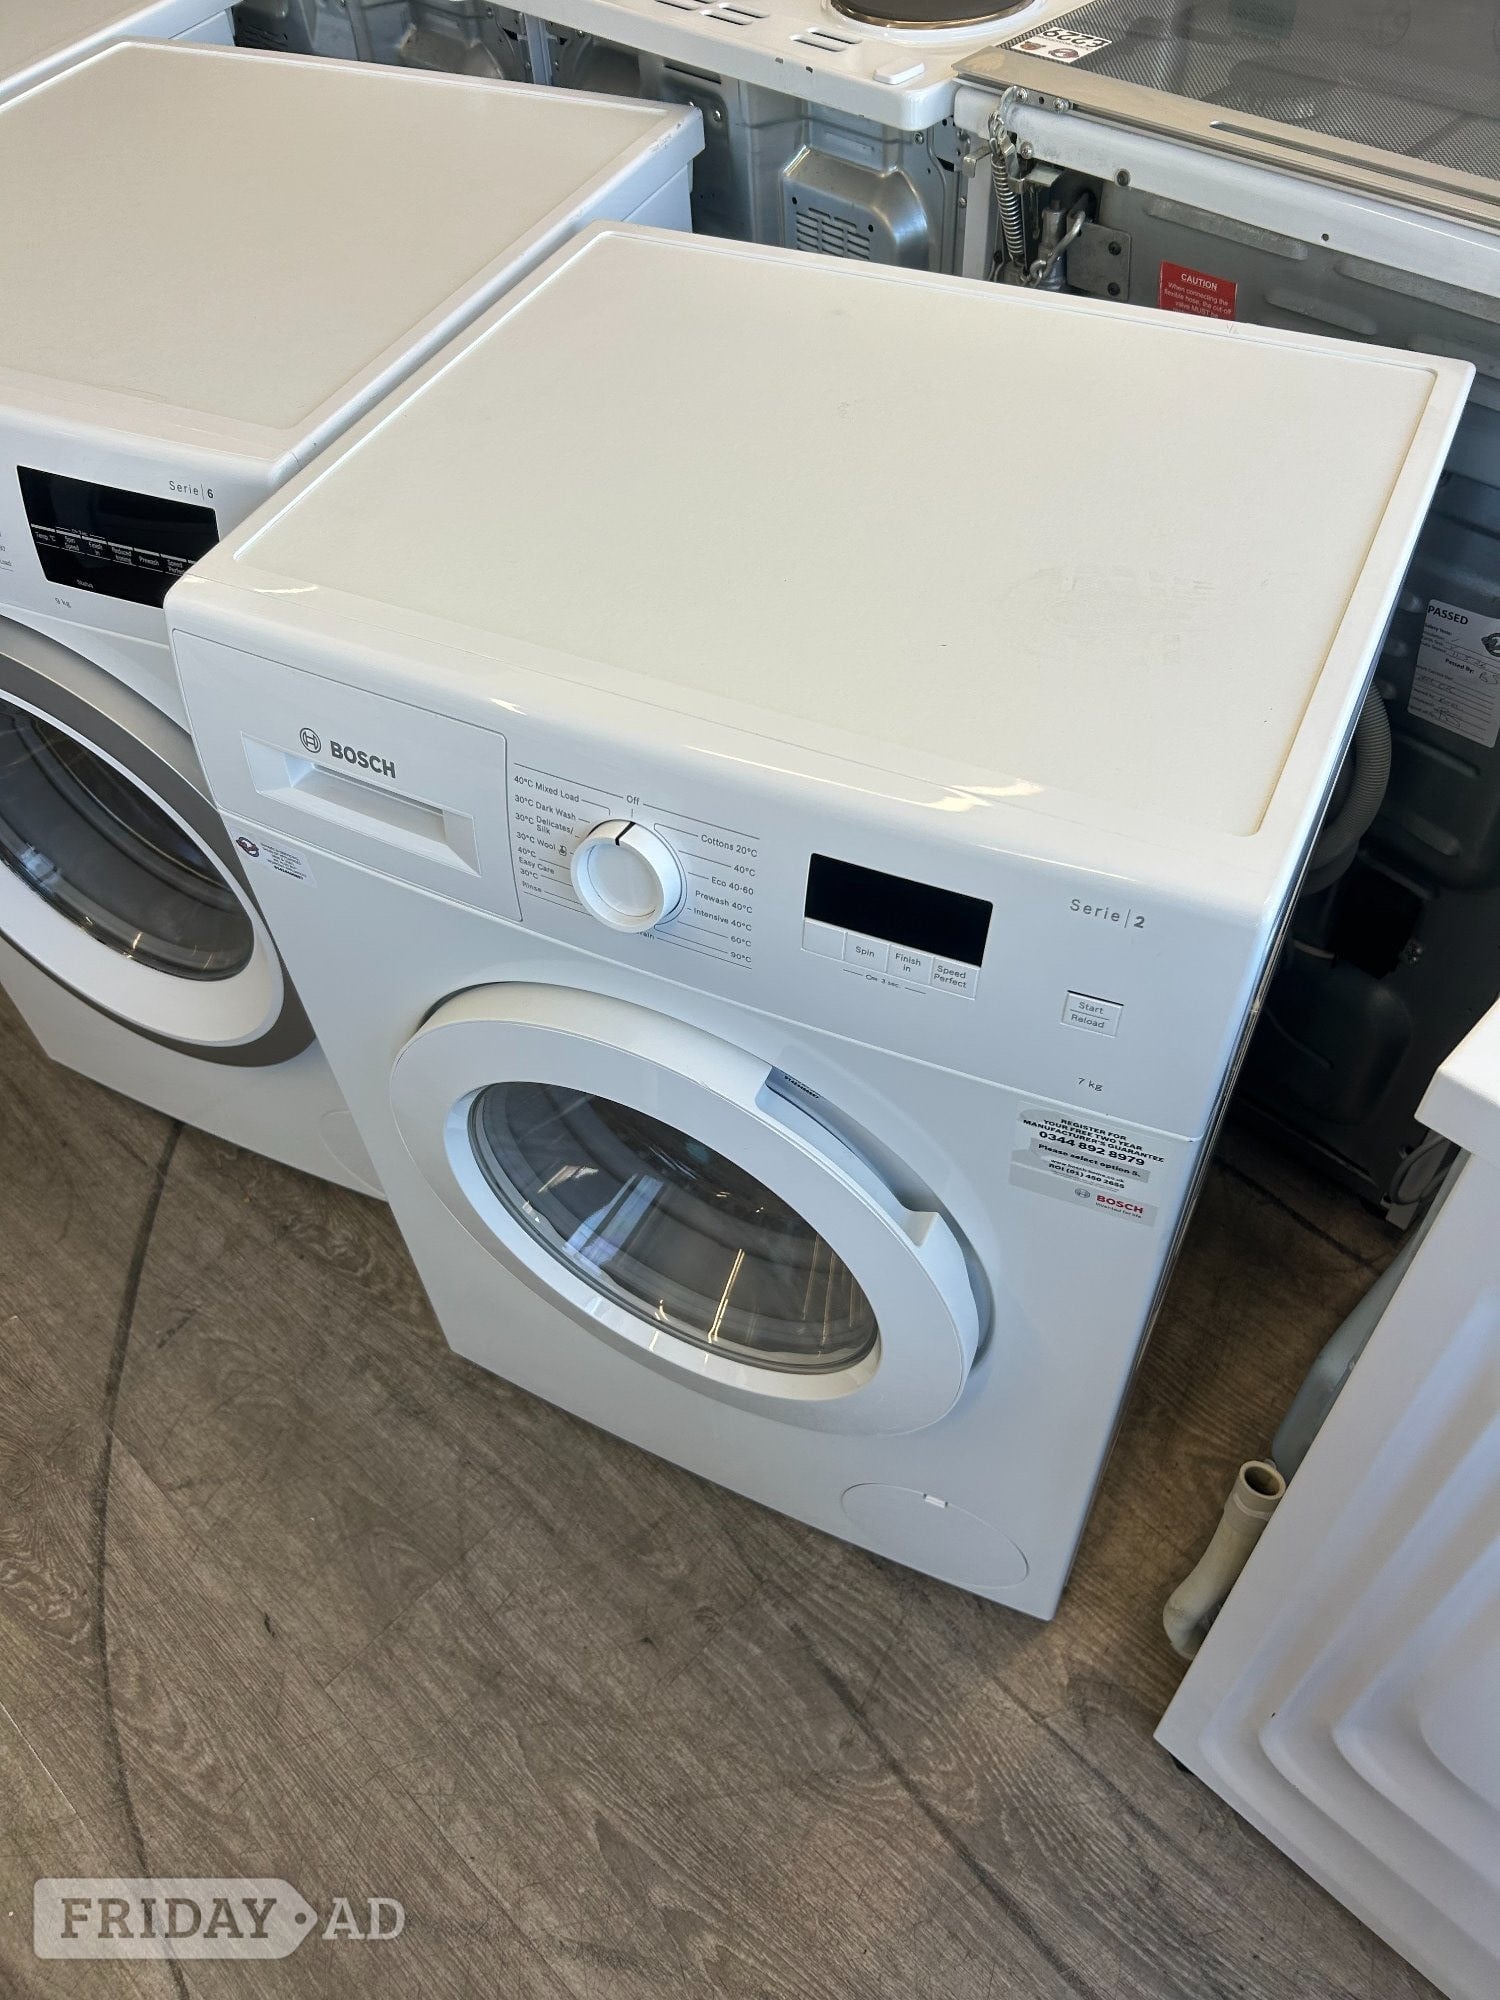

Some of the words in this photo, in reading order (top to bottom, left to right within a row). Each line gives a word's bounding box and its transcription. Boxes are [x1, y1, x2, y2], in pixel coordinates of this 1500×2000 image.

[1042, 29, 1109, 48] £229
[1181, 273, 1218, 291] CAUTION
[1186, 287, 1218, 304] connecting
[1191, 305, 1211, 315] MUST
[169, 481, 199, 496] Serie
[207, 488, 214, 499] 6
[1428, 605, 1469, 625] PASSED
[1445, 658, 1465, 670] Passed
[330, 740, 396, 778] BOSCH
[514, 776, 534, 787] 40°C
[536, 782, 558, 796] Mixed
[560, 790, 580, 802] Load
[514, 795, 534, 807] 30°C
[536, 801, 554, 814] Dark
[556, 808, 576, 820] Wash
[627, 795, 640, 805] Off
[515, 813, 534, 824] 30°C
[537, 816, 574, 834] Delicates/
[537, 824, 551, 835] Silk
[516, 832, 535, 844] 30°C
[537, 838, 556, 850] Wool
[701, 835, 735, 851] Cottons
[736, 844, 758, 857] 20°C
[518, 847, 536, 858] 40°C
[519, 857, 535, 868] Easy
[538, 864, 555, 875] Care
[520, 868, 538, 879] 30°C
[733, 864, 756, 877] 40°C
[522, 881, 542, 892] Rinse
[711, 877, 727, 887] Eco
[729, 882, 754, 895] 40-60
[695, 890, 729, 907] Prewash
[732, 902, 753, 914] 40°C
[694, 908, 729, 924] Intensive
[731, 917, 752, 931] 40°C
[1069, 898, 1120, 923] Serie
[1133, 916, 1146, 929] 2
[637, 931, 655, 940] rain
[731, 936, 752, 947] 60°C
[731, 951, 752, 963] 90°C
[855, 945, 875, 958] Spin
[895, 953, 921, 966] Finish
[934, 973, 967, 988] Perfect
[937, 965, 967, 979] Speed
[1078, 1001, 1104, 1014] Start
[1071, 1014, 1105, 1029] Reload
[1077, 1077, 1086, 1085] 7
[1088, 1079, 1103, 1092] kg
[1043, 1119, 1069, 1130] YOUR
[1070, 1126, 1094, 1137] FREE
[1095, 1133, 1117, 1144] TWO
[1118, 1140, 1143, 1151] YEAR
[1061, 1119, 1106, 1135] REGISTER
[1108, 1131, 1127, 1140] FOR
[1023, 1119, 1106, 1147] MANUFACTURER'S
[1107, 1143, 1165, 1163] GUARANTEE
[1039, 1131, 1075, 1147] 0344
[1078, 1142, 1105, 1155] 892
[1108, 1150, 1145, 1166] 8979
[1038, 1143, 1069, 1157] Please
[1070, 1153, 1098, 1165] select
[1100, 1161, 1130, 1174] option
[1048, 1163, 1064, 1171] ROI
[1066, 1168, 1084, 1177] (01)
[1096, 1194, 1144, 1213] BOSCH
